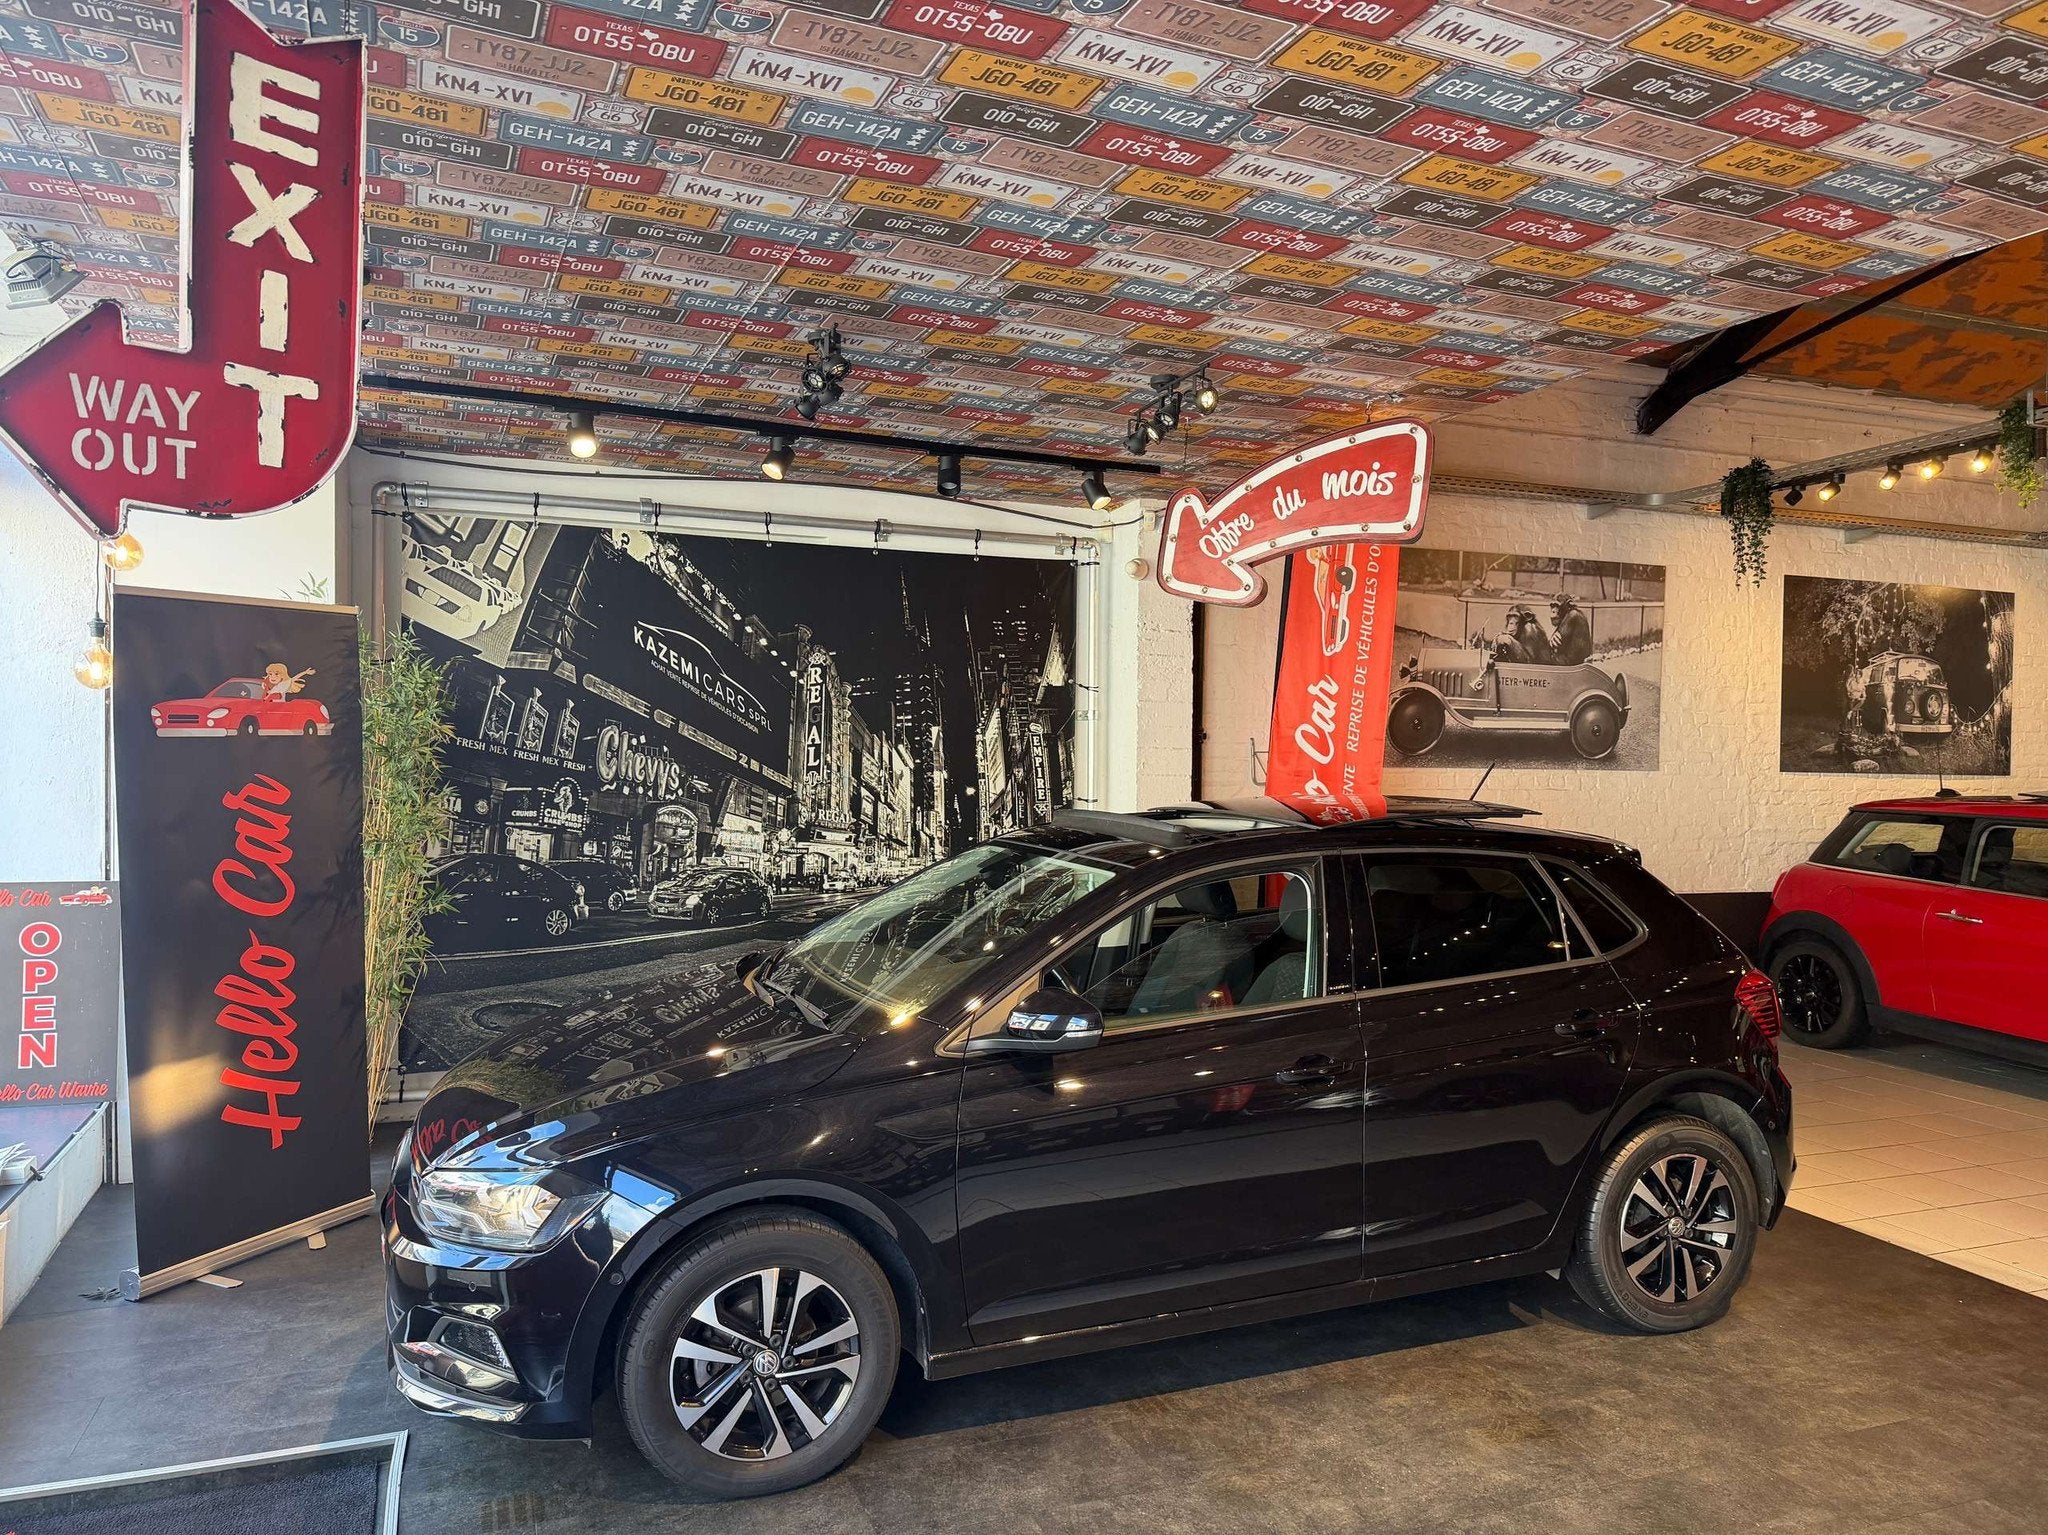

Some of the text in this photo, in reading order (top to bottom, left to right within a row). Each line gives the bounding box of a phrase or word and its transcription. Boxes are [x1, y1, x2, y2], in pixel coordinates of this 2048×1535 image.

[950, 0, 981, 13] TEXAS
[604, 21, 633, 33] TEXAS
[732, 15, 752, 29] 15
[1700, 22, 1774, 44] NEW YORK
[399, 28, 418, 42] 15
[85, 45, 108, 58] 15
[1336, 41, 1412, 61] NEW YORK
[1661, 32, 1753, 63] JGO-481
[992, 59, 1070, 79] NEW YORK
[1305, 51, 1396, 80] JGO-481
[1560, 62, 1592, 75] 66
[671, 77, 750, 96] NEW YORK
[970, 68, 1061, 96] JGO-481
[1221, 80, 1249, 93] 66
[1782, 59, 1879, 96] GEH-142A
[655, 85, 745, 112] JGO-481
[902, 95, 927, 107] 66
[1436, 78, 1533, 113] GEH-142A
[76, 110, 169, 135] JGO-481
[1109, 95, 1208, 128] GEH-142A
[1565, 114, 1588, 125] 15
[800, 110, 901, 141] GEH-142A
[1250, 129, 1269, 140] 15
[1450, 119, 1475, 129] TEXAS
[508, 122, 611, 152] GEH-142A
[1139, 134, 1163, 143] TEXAS
[844, 147, 868, 155] TEXAS
[1725, 155, 1803, 178] JGO-481
[1140, 181, 1216, 202] JGO-481
[1425, 170, 1502, 192] JGO-481
[1824, 173, 1905, 200] GEH-142A
[869, 190, 944, 210] JGO-481
[1531, 188, 1614, 213] GEH-142A
[986, 210, 1071, 233] GEH-142A
[1252, 200, 1335, 225] GEH-142A
[490, 227, 577, 249] GEH-142A
[733, 218, 818, 241] GEH-142A
[223, 52, 321, 468] EXIT
[68, 372, 201, 431] WAY
[71, 427, 197, 479] OUT
[1199, 462, 1397, 560] Offre du mois
[633, 625, 772, 732] KAZEMI CARS SPRL
[650, 659, 666, 674] ACHAT
[667, 669, 682, 685] VENTE
[682, 681, 701, 697] REPRISE
[1354, 665, 1367, 685] DE
[807, 666, 823, 767] REGAL
[1294, 674, 1340, 764] Car
[1345, 686, 1365, 752] REPRISE
[456, 737, 586, 772] FRESH MEX FRESH MEX FRESH
[596, 725, 680, 801] Chevys
[1032, 735, 1046, 800] EMPIRE
[511, 810, 538, 818] CRUMBS
[543, 808, 583, 823] CRUMBS
[19, 888, 52, 908] Car
[212, 773, 302, 1150] Hello Car
[18, 921, 63, 1070] OPEN
[26, 1082, 56, 1100] Car
